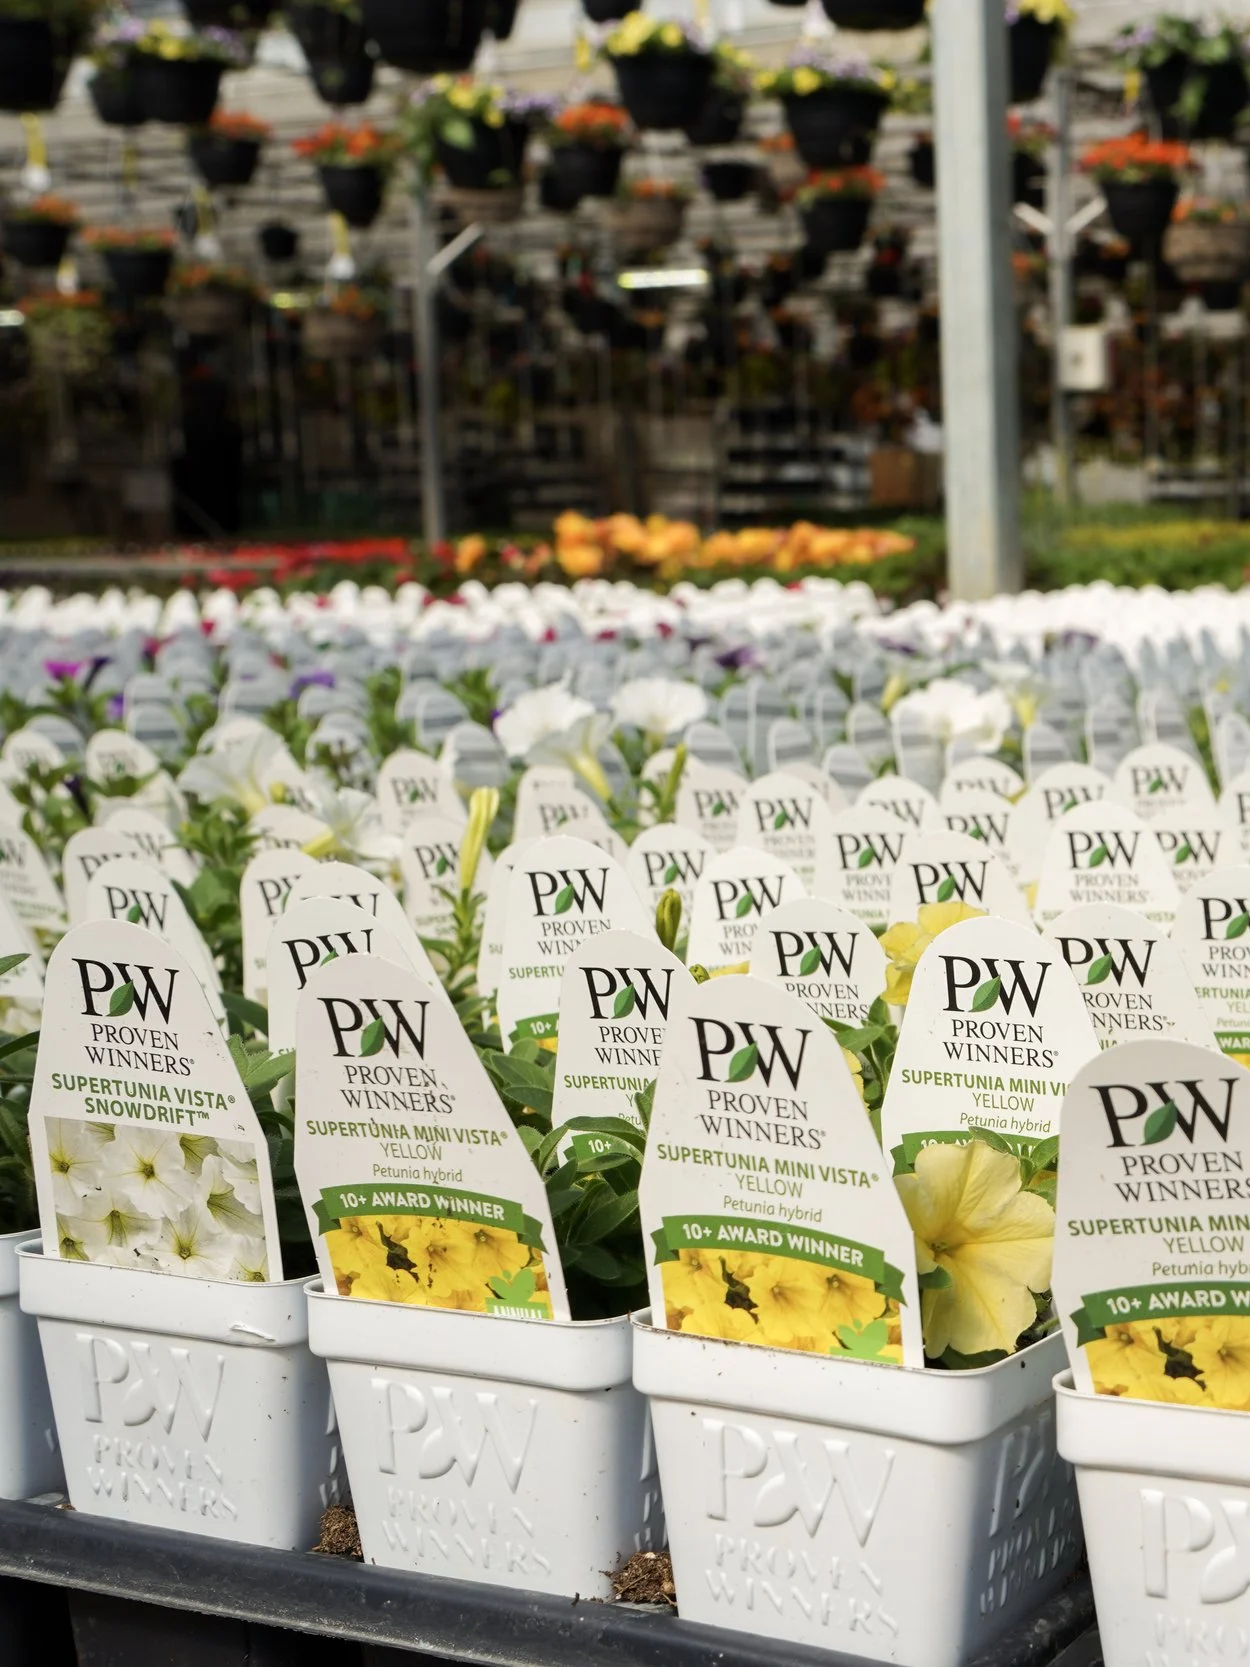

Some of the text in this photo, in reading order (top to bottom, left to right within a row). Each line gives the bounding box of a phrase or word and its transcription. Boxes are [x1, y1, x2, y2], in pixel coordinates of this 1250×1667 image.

[390, 777, 439, 804] PW
[1130, 765, 1189, 795] PW
[754, 798, 813, 831] PW
[835, 833, 905, 871] PW
[1065, 831, 1141, 869] PW
[642, 851, 706, 887] PW
[908, 861, 990, 905] PW
[1074, 874, 1140, 886] PROVEN
[525, 867, 610, 916] PW
[711, 875, 786, 921] PW
[103, 886, 169, 931] PW
[769, 930, 860, 978] PW
[72, 958, 179, 1025] PW
[579, 967, 675, 1021] PW
[938, 955, 1052, 1018] PW
[1082, 992, 1153, 1010] ROVEN
[91, 1023, 179, 1051] PROVEN
[317, 997, 430, 1060] PW
[599, 1026, 666, 1045] PROVE
[951, 1019, 1043, 1044] PROVEN
[688, 1016, 813, 1092] PW
[52, 1073, 173, 1102] SUPERTUNIA
[344, 1065, 438, 1088] PROVEN
[902, 1069, 1005, 1091] SUPERTUNIA
[1009, 1078, 1046, 1095] MINI
[707, 1089, 809, 1121] PROVEN
[972, 1093, 1034, 1112] YELLOW
[1089, 1077, 1240, 1148] PW
[306, 1120, 410, 1140] SUPERTUNIA
[413, 1125, 451, 1143] MINI
[960, 1112, 1052, 1133] Petunia hybrid
[380, 1142, 442, 1161] YELLOW
[657, 1143, 770, 1174] SUPERTUNIA
[775, 1159, 815, 1180] MINI
[1121, 1151, 1244, 1177] PROVEN
[373, 1164, 463, 1184] Petunia hybrid
[734, 1173, 803, 1199] YELLOW
[340, 1191, 505, 1219] 10+ AWARD WINNER
[723, 1195, 823, 1224] Petunia hybrid
[1067, 1214, 1202, 1237] SUPERTUNIA
[682, 1223, 864, 1268] 10+ AWARD WINNER
[1163, 1236, 1244, 1255] YELLOW
[1151, 1262, 1214, 1277] Petunia
[1106, 1297, 1142, 1315] 10+
[1148, 1290, 1226, 1311] AWARD
